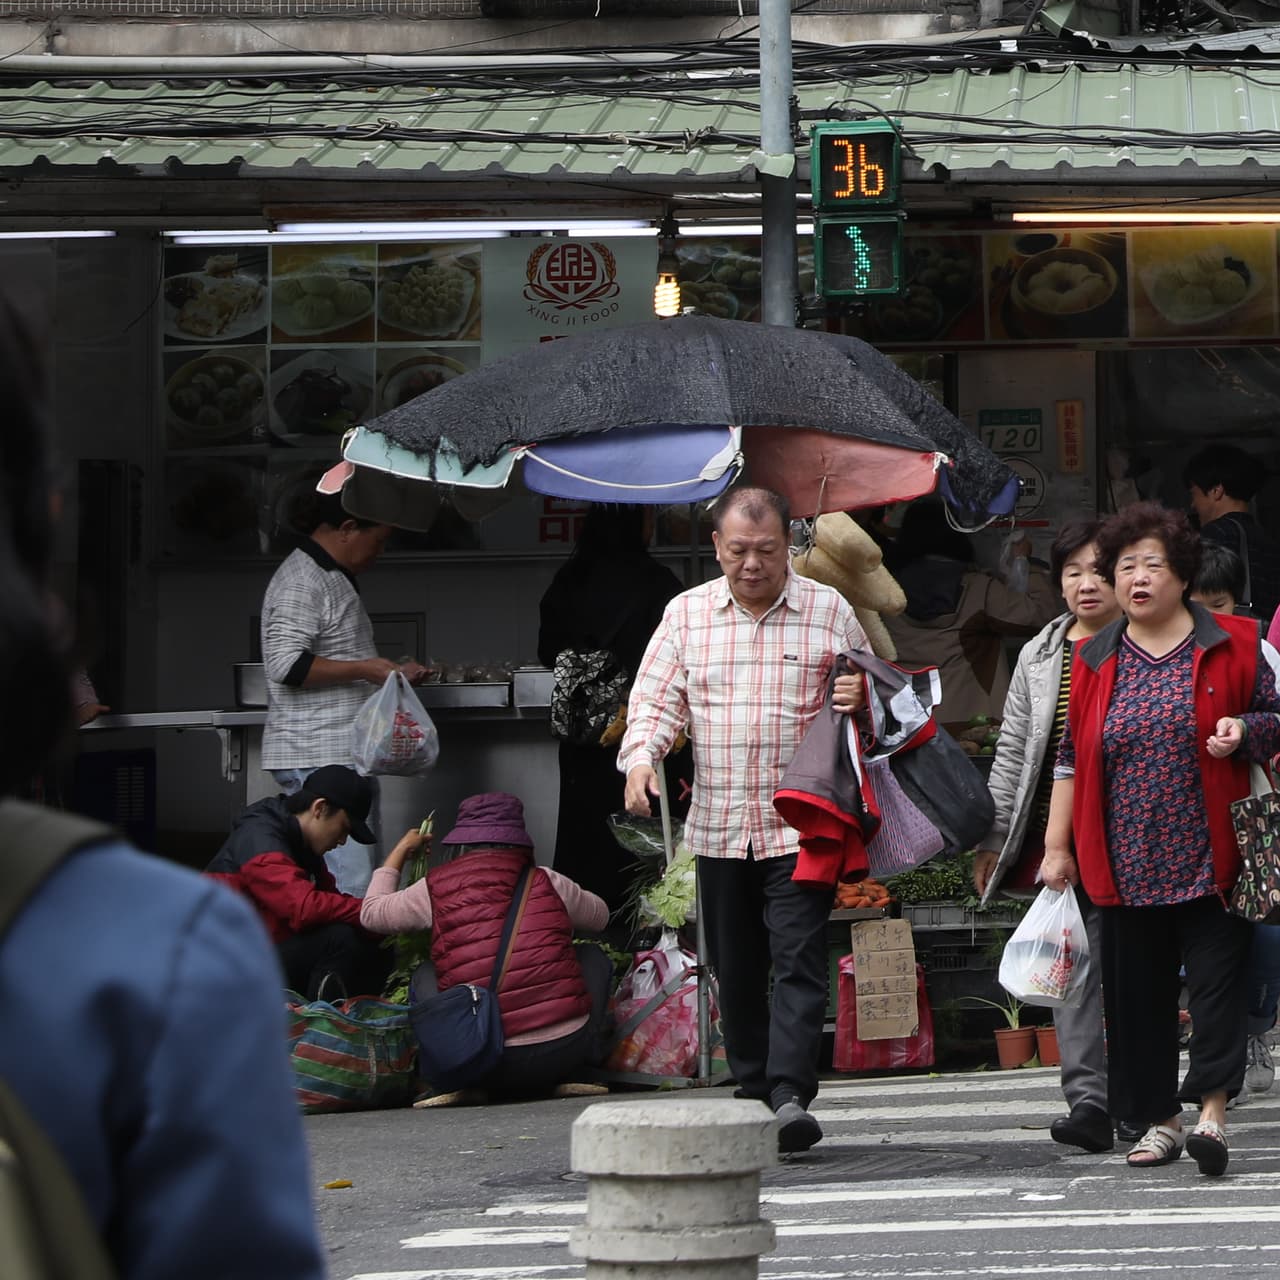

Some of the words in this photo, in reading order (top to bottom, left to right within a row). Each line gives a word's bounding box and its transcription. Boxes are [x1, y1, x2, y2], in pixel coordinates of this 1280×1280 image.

[834, 139, 885, 198] 36
[527, 303, 560, 324] XING
[583, 302, 619, 325] FOOD
[985, 428, 1038, 449] 120
